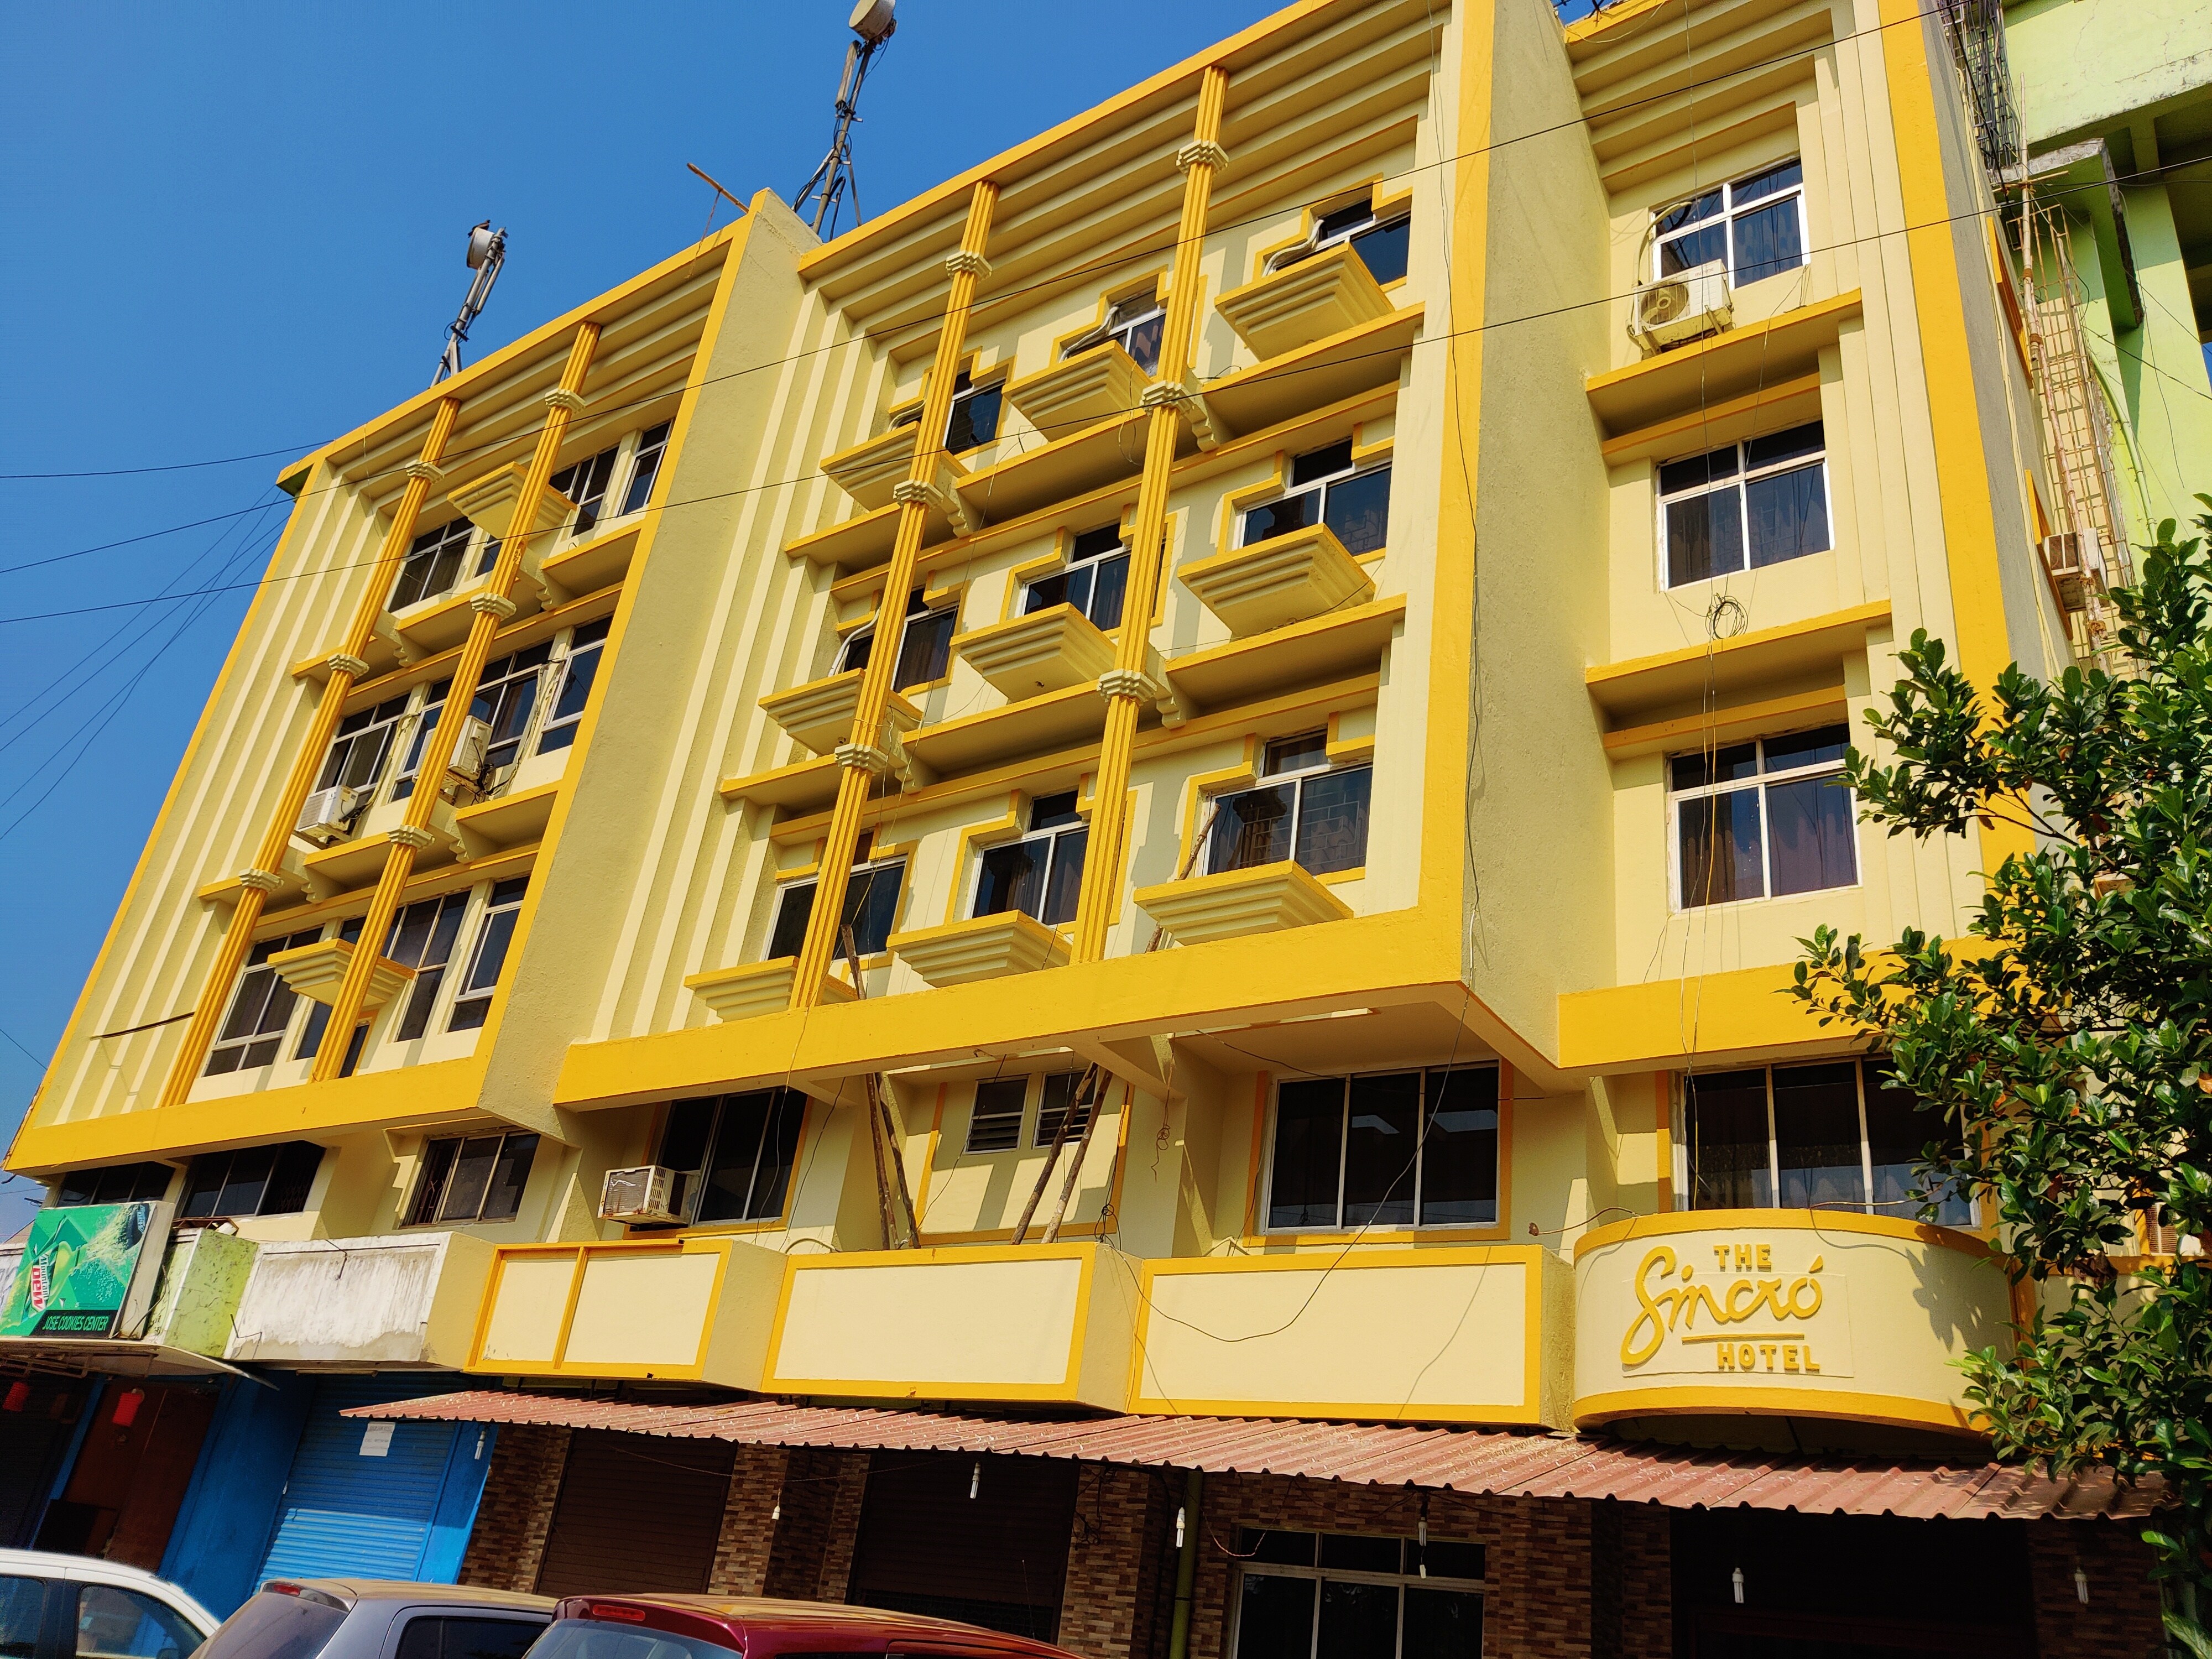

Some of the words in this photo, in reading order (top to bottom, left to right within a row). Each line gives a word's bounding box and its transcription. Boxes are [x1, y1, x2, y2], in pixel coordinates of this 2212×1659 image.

[1713, 1244, 1771, 1271] THE
[40, 1255, 49, 1300] Mountain
[42, 1316, 60, 1330] JOSE
[58, 1316, 85, 1331] COOKIES
[83, 1316, 109, 1331] CENTER
[1717, 1343, 1820, 1373] HOTEL
